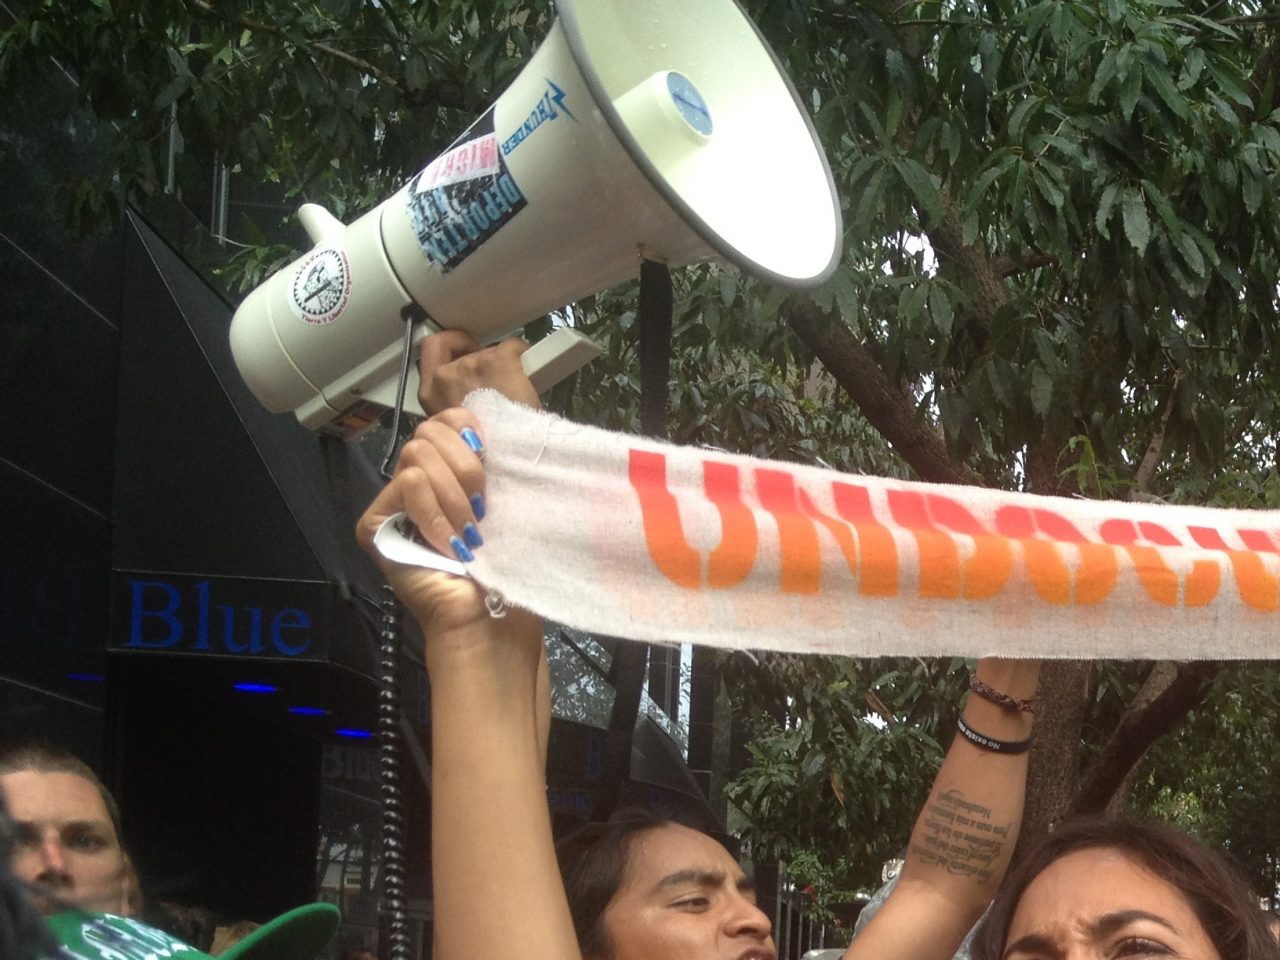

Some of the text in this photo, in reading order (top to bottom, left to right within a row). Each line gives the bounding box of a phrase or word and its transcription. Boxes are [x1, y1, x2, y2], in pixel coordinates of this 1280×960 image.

[502, 91, 559, 156] THUNDER
[302, 314, 321, 324] Tierra
[122, 579, 314, 656] Blue
